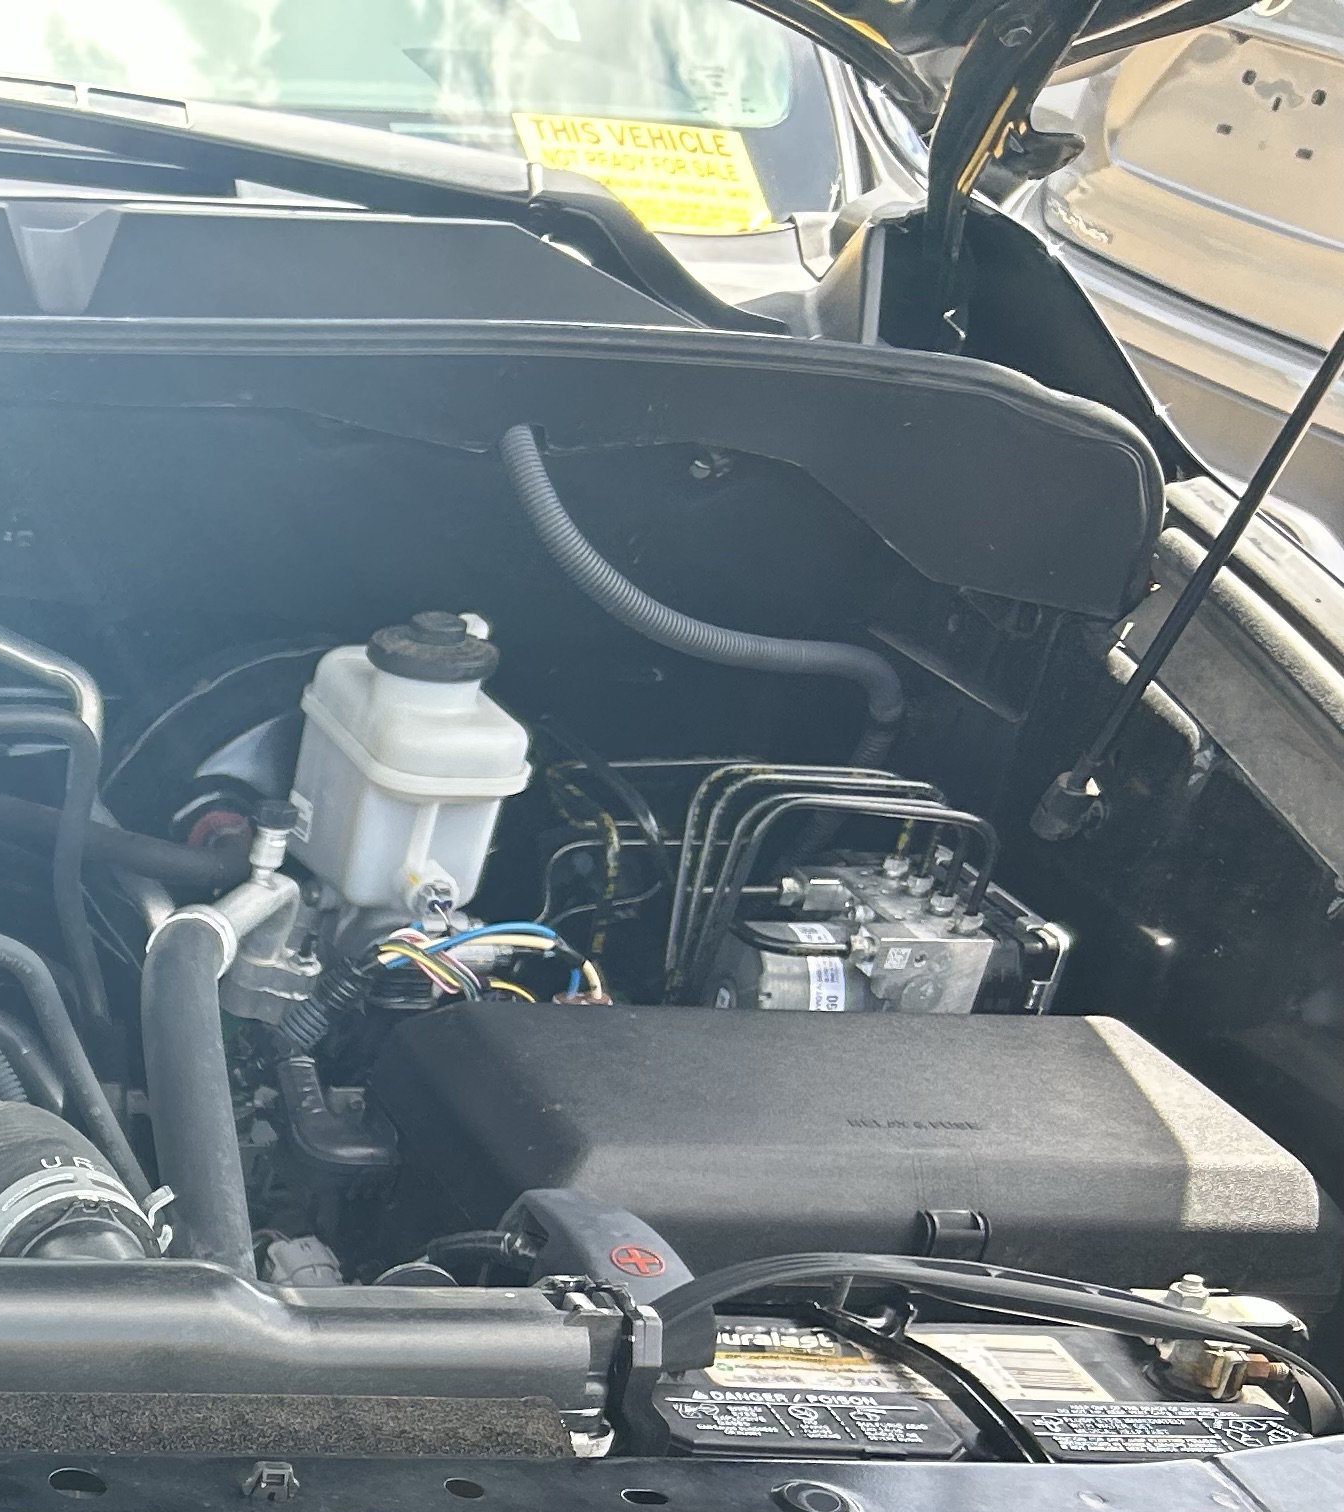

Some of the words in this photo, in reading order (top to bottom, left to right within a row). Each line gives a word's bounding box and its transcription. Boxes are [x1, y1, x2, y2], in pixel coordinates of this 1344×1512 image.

[531, 118, 601, 145] THIS
[607, 124, 733, 158] VEHICLE
[542, 149, 577, 167] NOT
[585, 151, 645, 171] READY
[651, 156, 690, 176] FOR
[692, 160, 741, 182] SALE
[716, 1331, 833, 1350] uralast
[709, 1390, 789, 1403] DANGER
[805, 1394, 878, 1406] POISON
